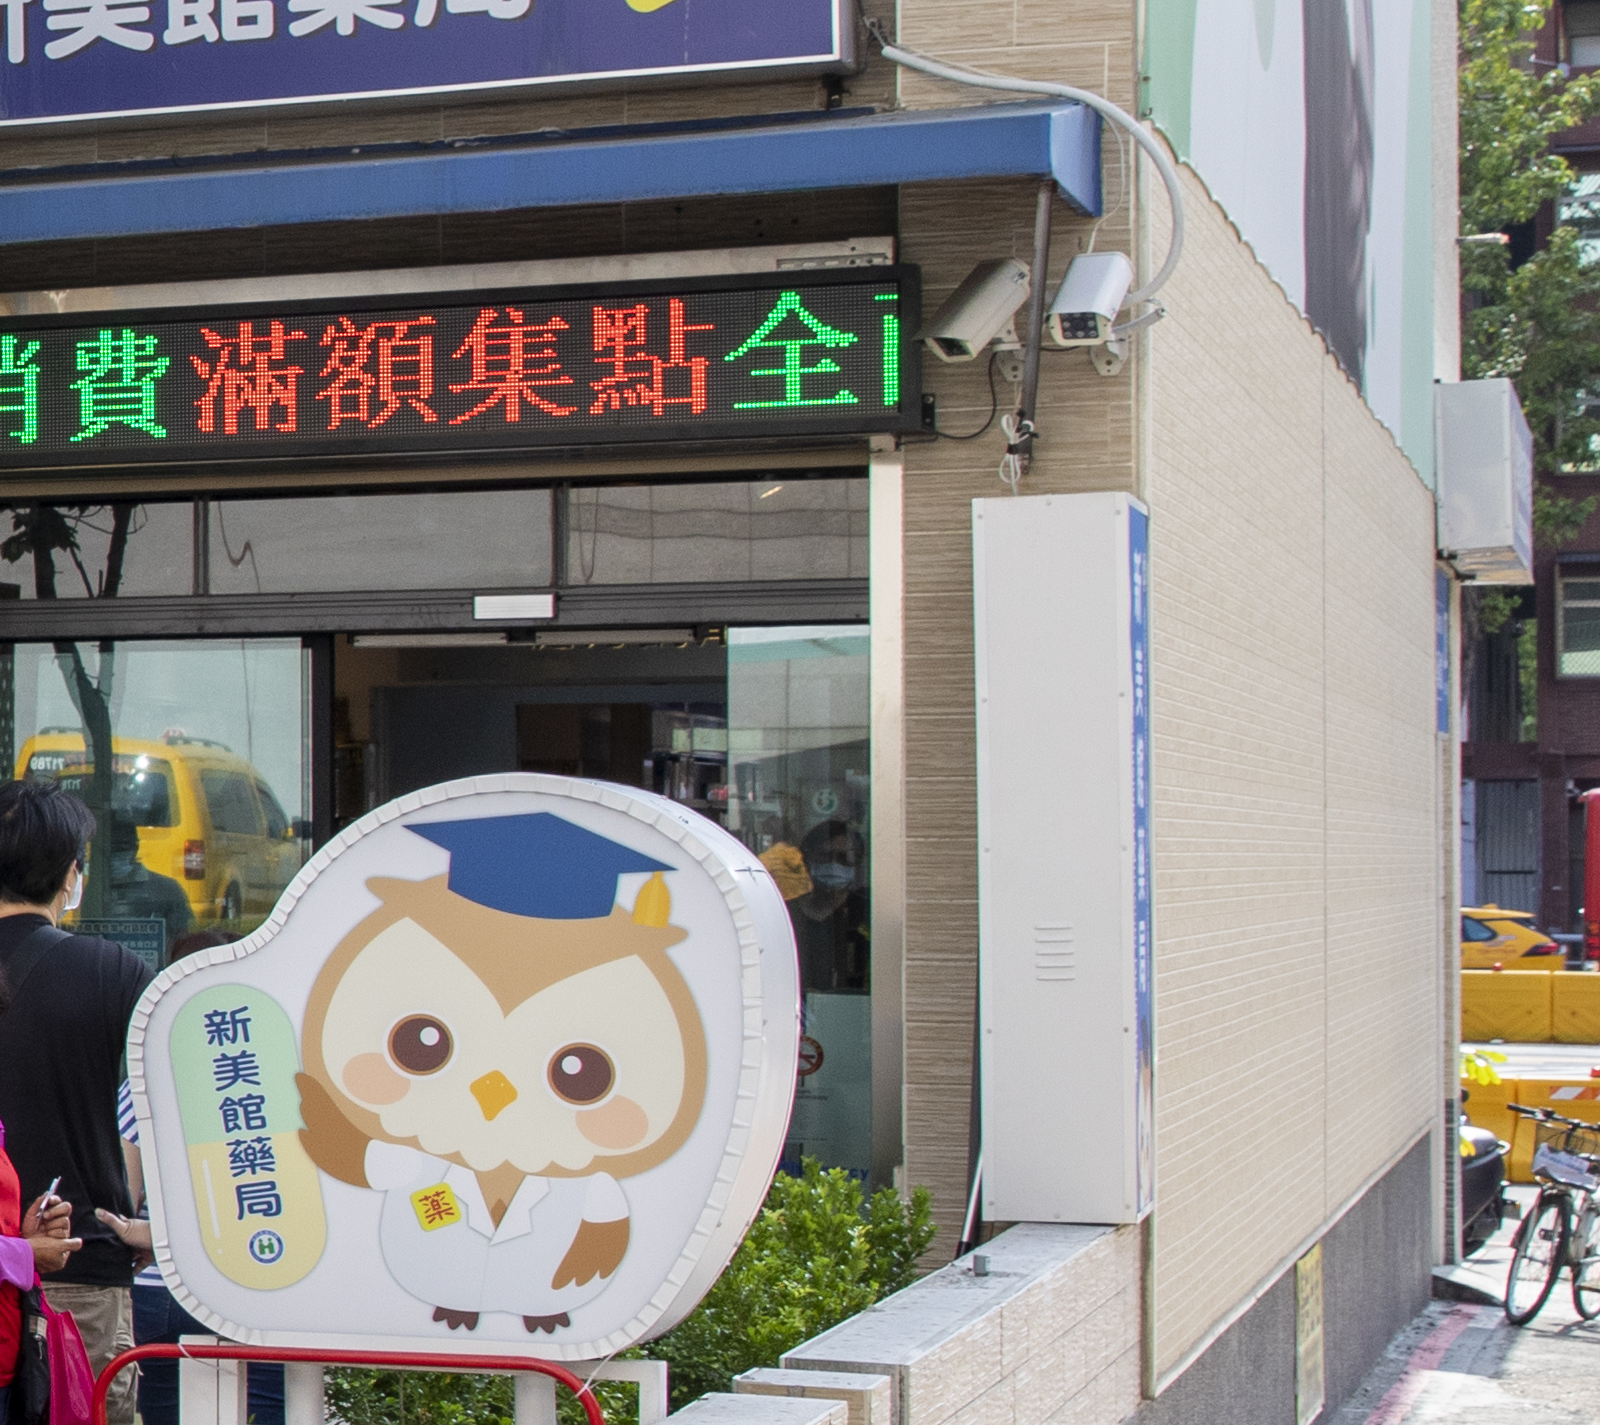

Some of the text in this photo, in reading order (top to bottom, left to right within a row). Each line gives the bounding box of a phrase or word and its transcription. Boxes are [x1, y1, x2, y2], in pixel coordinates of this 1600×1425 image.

[203, 1003, 283, 1222] 新美館藥局
